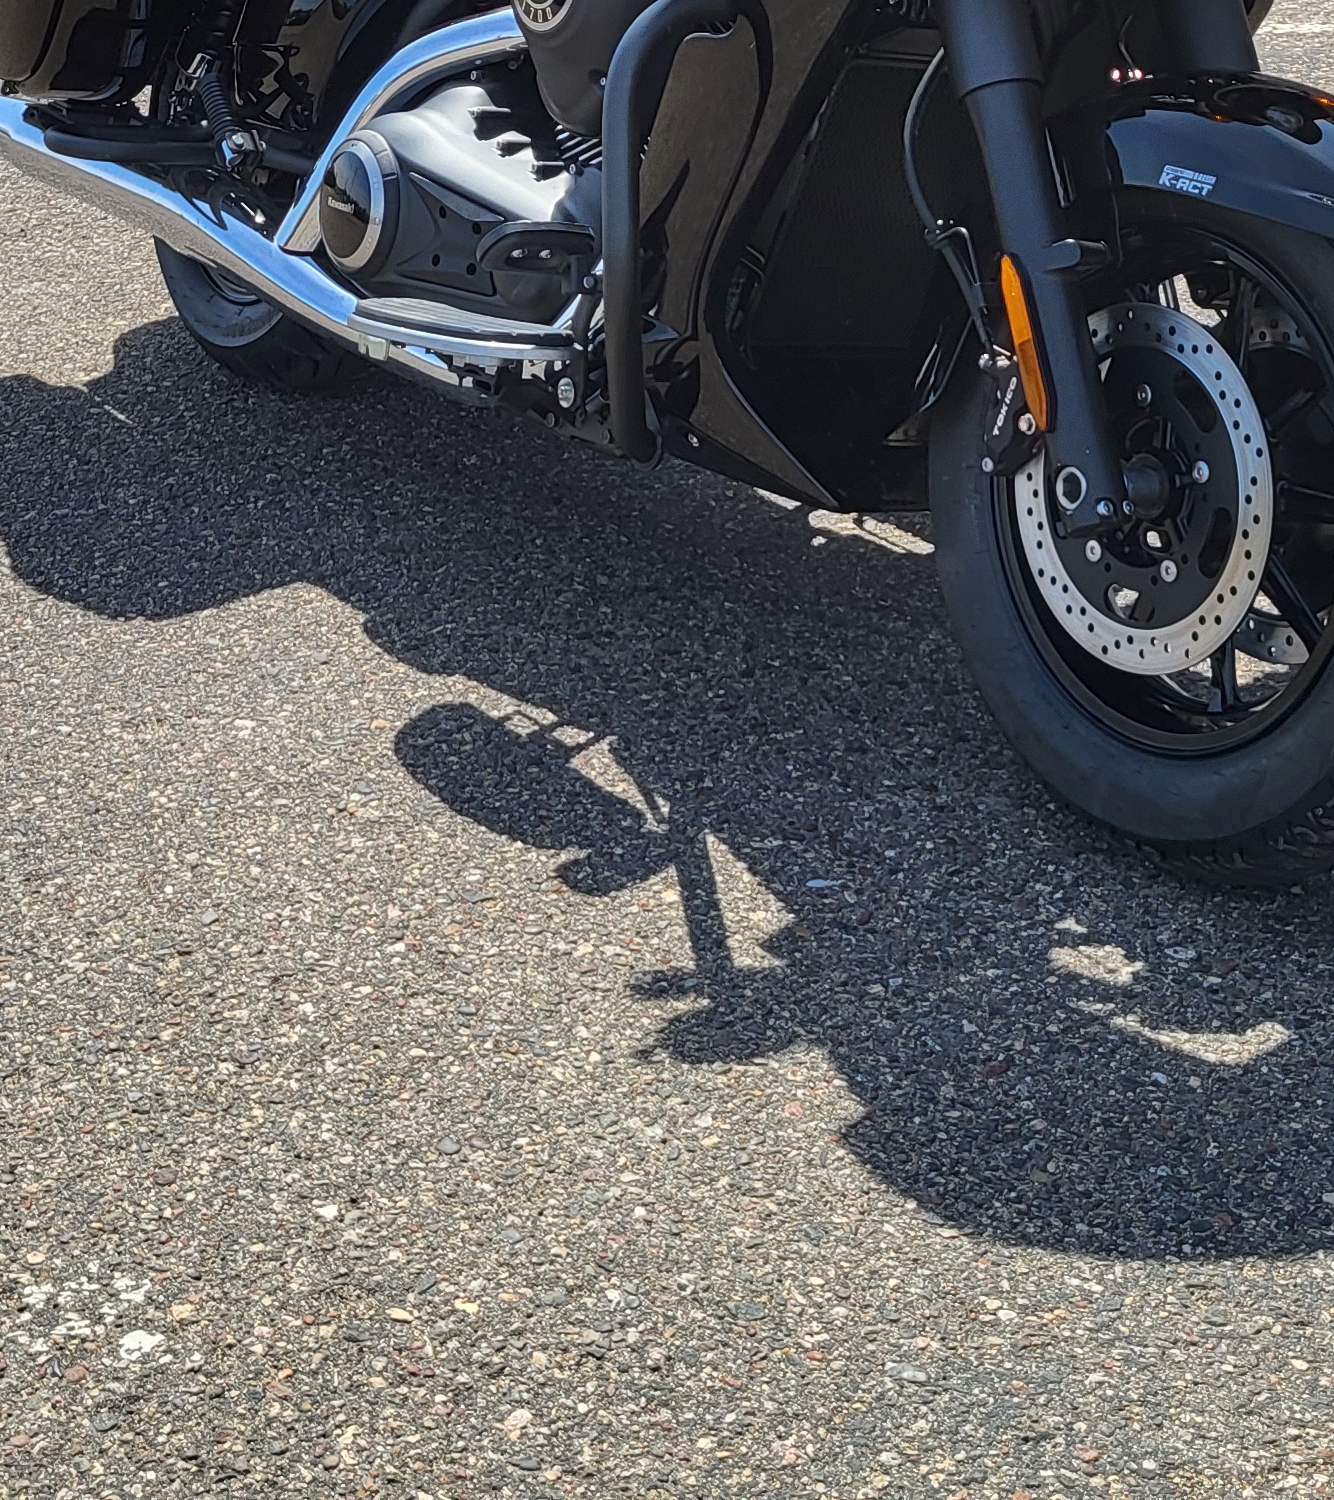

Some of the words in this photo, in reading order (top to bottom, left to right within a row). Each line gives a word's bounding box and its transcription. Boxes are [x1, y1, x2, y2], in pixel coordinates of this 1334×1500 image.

[521, 0, 553, 23] 1700
[1158, 172, 1214, 196] K-ACT
[992, 376, 1017, 436] TOKICO
